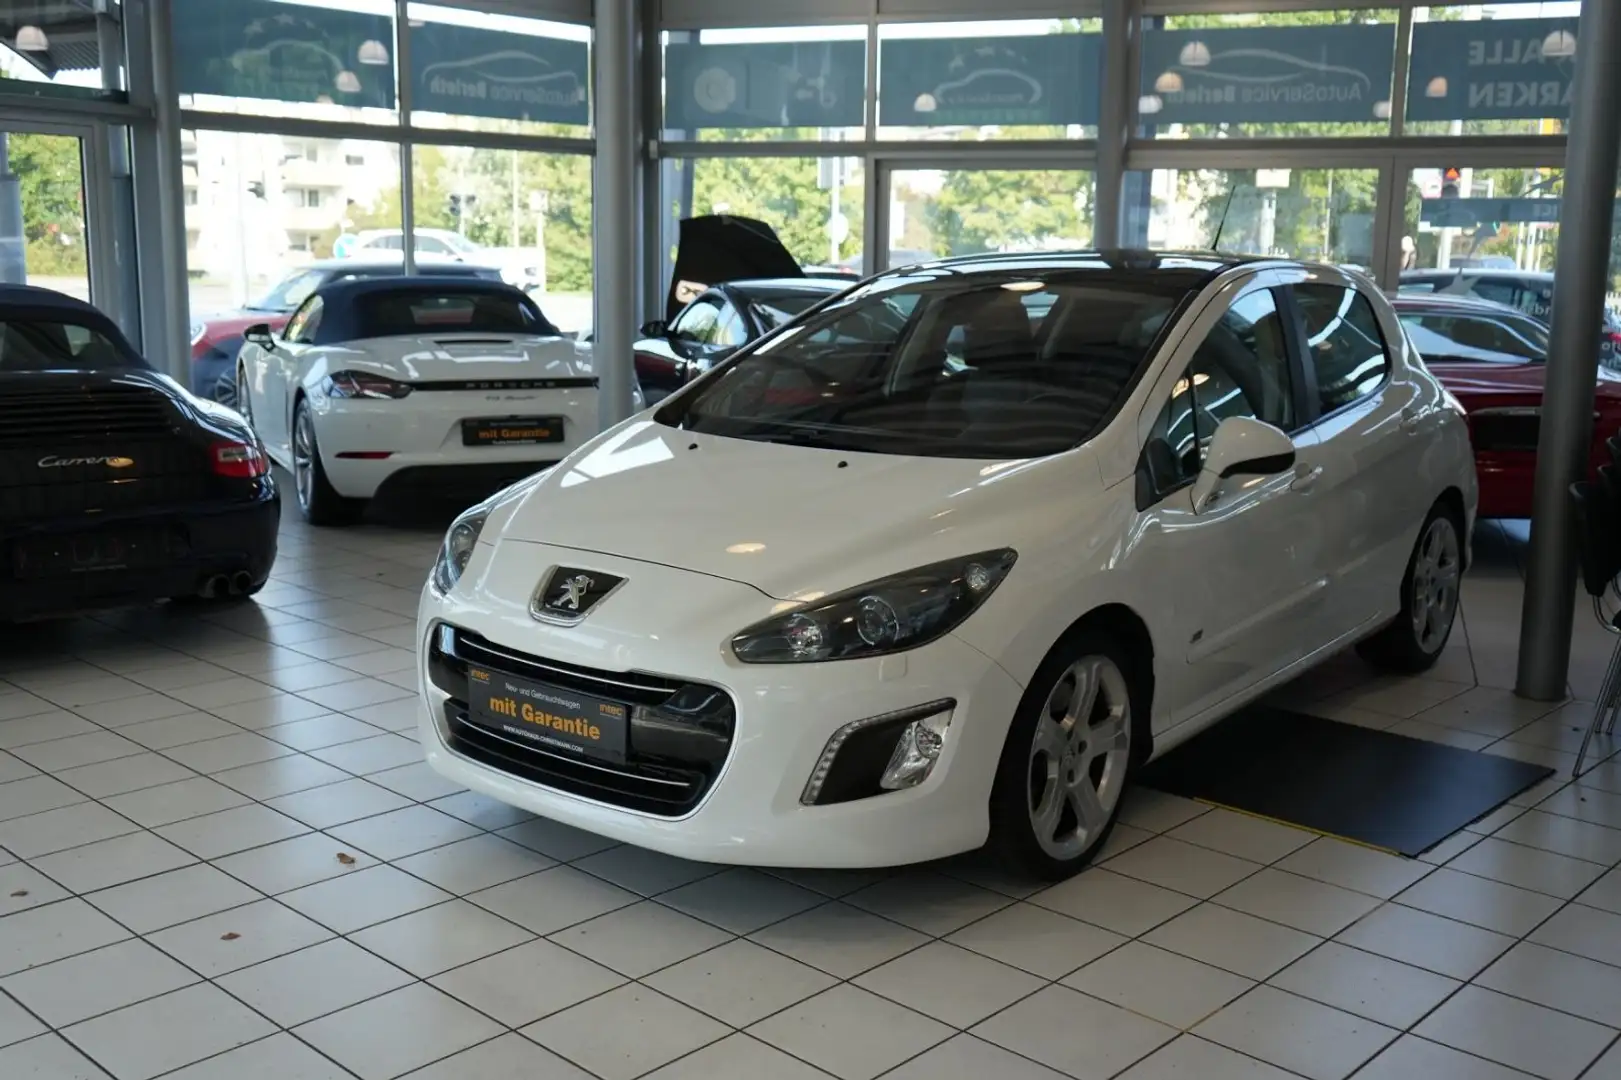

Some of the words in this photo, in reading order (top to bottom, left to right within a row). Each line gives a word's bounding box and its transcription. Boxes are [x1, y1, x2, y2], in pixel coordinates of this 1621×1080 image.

[530, 688, 581, 709] Gebrauchtwagen
[489, 695, 517, 718] mit
[521, 703, 601, 741] Garantie
